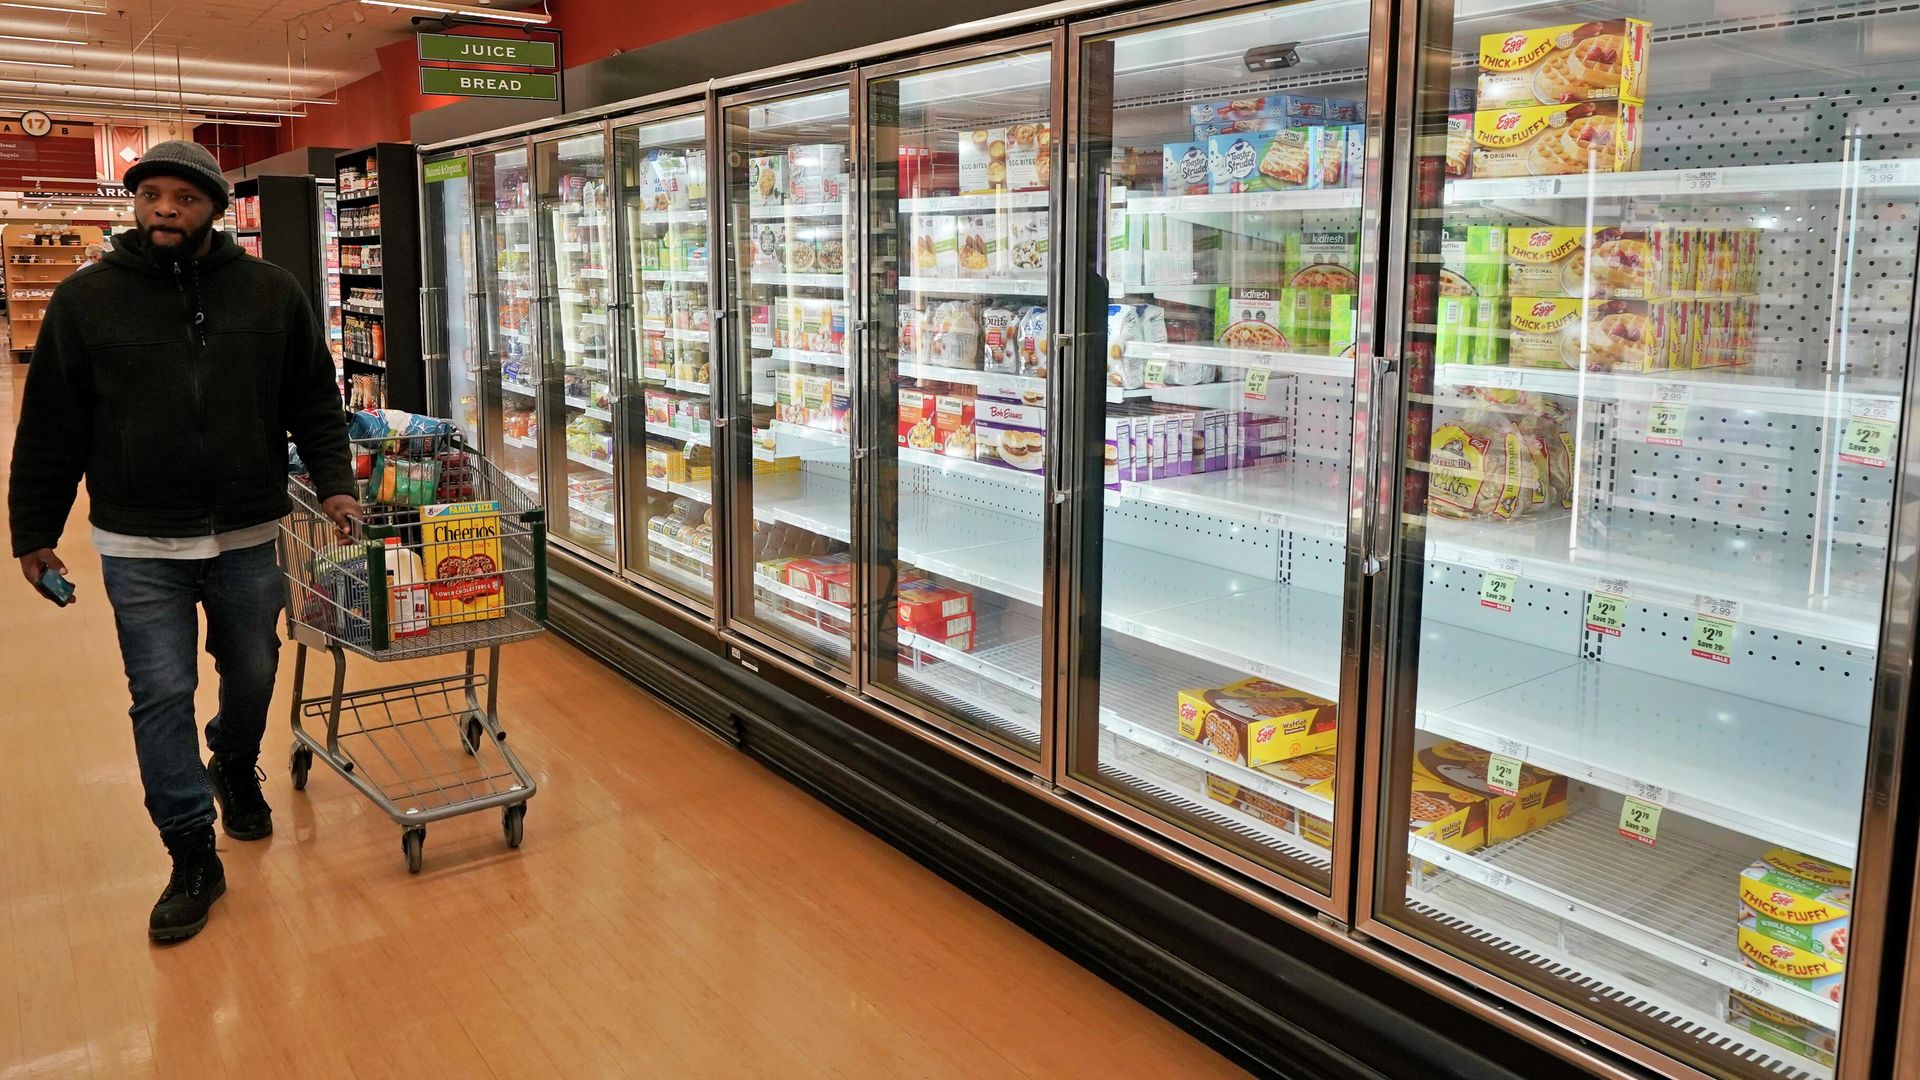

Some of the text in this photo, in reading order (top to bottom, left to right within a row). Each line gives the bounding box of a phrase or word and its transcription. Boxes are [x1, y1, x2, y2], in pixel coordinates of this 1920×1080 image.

[1502, 36, 1528, 53] Eggo
[460, 44, 516, 58] JUICE
[1483, 54, 1511, 68] THICK
[1518, 38, 1553, 66] FLUFFY
[460, 77, 522, 91] BREAD
[1494, 75, 1524, 83] ORIGINAL
[26, 118, 46, 129] 17
[1495, 113, 1522, 130] Eggo
[4, 124, 11, 132] A
[62, 127, 69, 135] B
[1478, 130, 1505, 145] THICK
[1512, 117, 1547, 143] FLUFFY
[1230, 150, 1252, 161] Toaster
[1020, 158, 1036, 166] BITES
[1184, 158, 1205, 167] Toaster
[1227, 159, 1255, 174] Strudel
[1870, 173, 1894, 183] 3.99
[1690, 180, 1711, 190] 3.99
[1312, 234, 1343, 243] kidfresh
[1528, 232, 1553, 247] Eggo
[1511, 245, 1539, 260] THICK
[1545, 236, 1577, 259] FLUFFY
[1240, 289, 1269, 300] kidfresh
[1531, 302, 1557, 317] Eggo
[1514, 315, 1541, 331] THICK
[1546, 309, 1579, 331] FLUFFY
[1662, 392, 1682, 401] 2.99
[990, 406, 1023, 420] Bob Evans
[1863, 407, 1887, 418] 2.99
[1651, 426, 1667, 434] Save
[1848, 442, 1867, 452] Save
[449, 503, 494, 514] FAMILY SIZE
[435, 524, 496, 543] Cheerios
[1605, 584, 1624, 594] 2.99
[1486, 592, 1498, 600] Save
[1496, 603, 1510, 611] SALE
[1710, 605, 1731, 616] 2.99
[1592, 614, 1606, 623] Save
[1604, 628, 1620, 636] SALE
[1697, 639, 1713, 649] Save
[1711, 653, 1729, 663] SALE
[1283, 719, 1307, 729] Waffles
[1256, 726, 1276, 744] Eggo
[1491, 776, 1504, 786] Save
[1503, 789, 1517, 797] SALE
[1639, 788, 1657, 800] 2.99
[1441, 820, 1462, 834] Waffles
[1625, 820, 1640, 831] Save
[1638, 835, 1654, 845] SALE
[1768, 857, 1804, 875] THICK
[1743, 890, 1778, 916] THICK
[1787, 908, 1829, 921] FLUFFY
[1760, 919, 1785, 931] WHOLE
[1785, 926, 1809, 941] GRAIN
[1743, 941, 1778, 968] THICK
[1787, 962, 1829, 975] FLUFFY
[1740, 983, 1762, 997] 3.79
